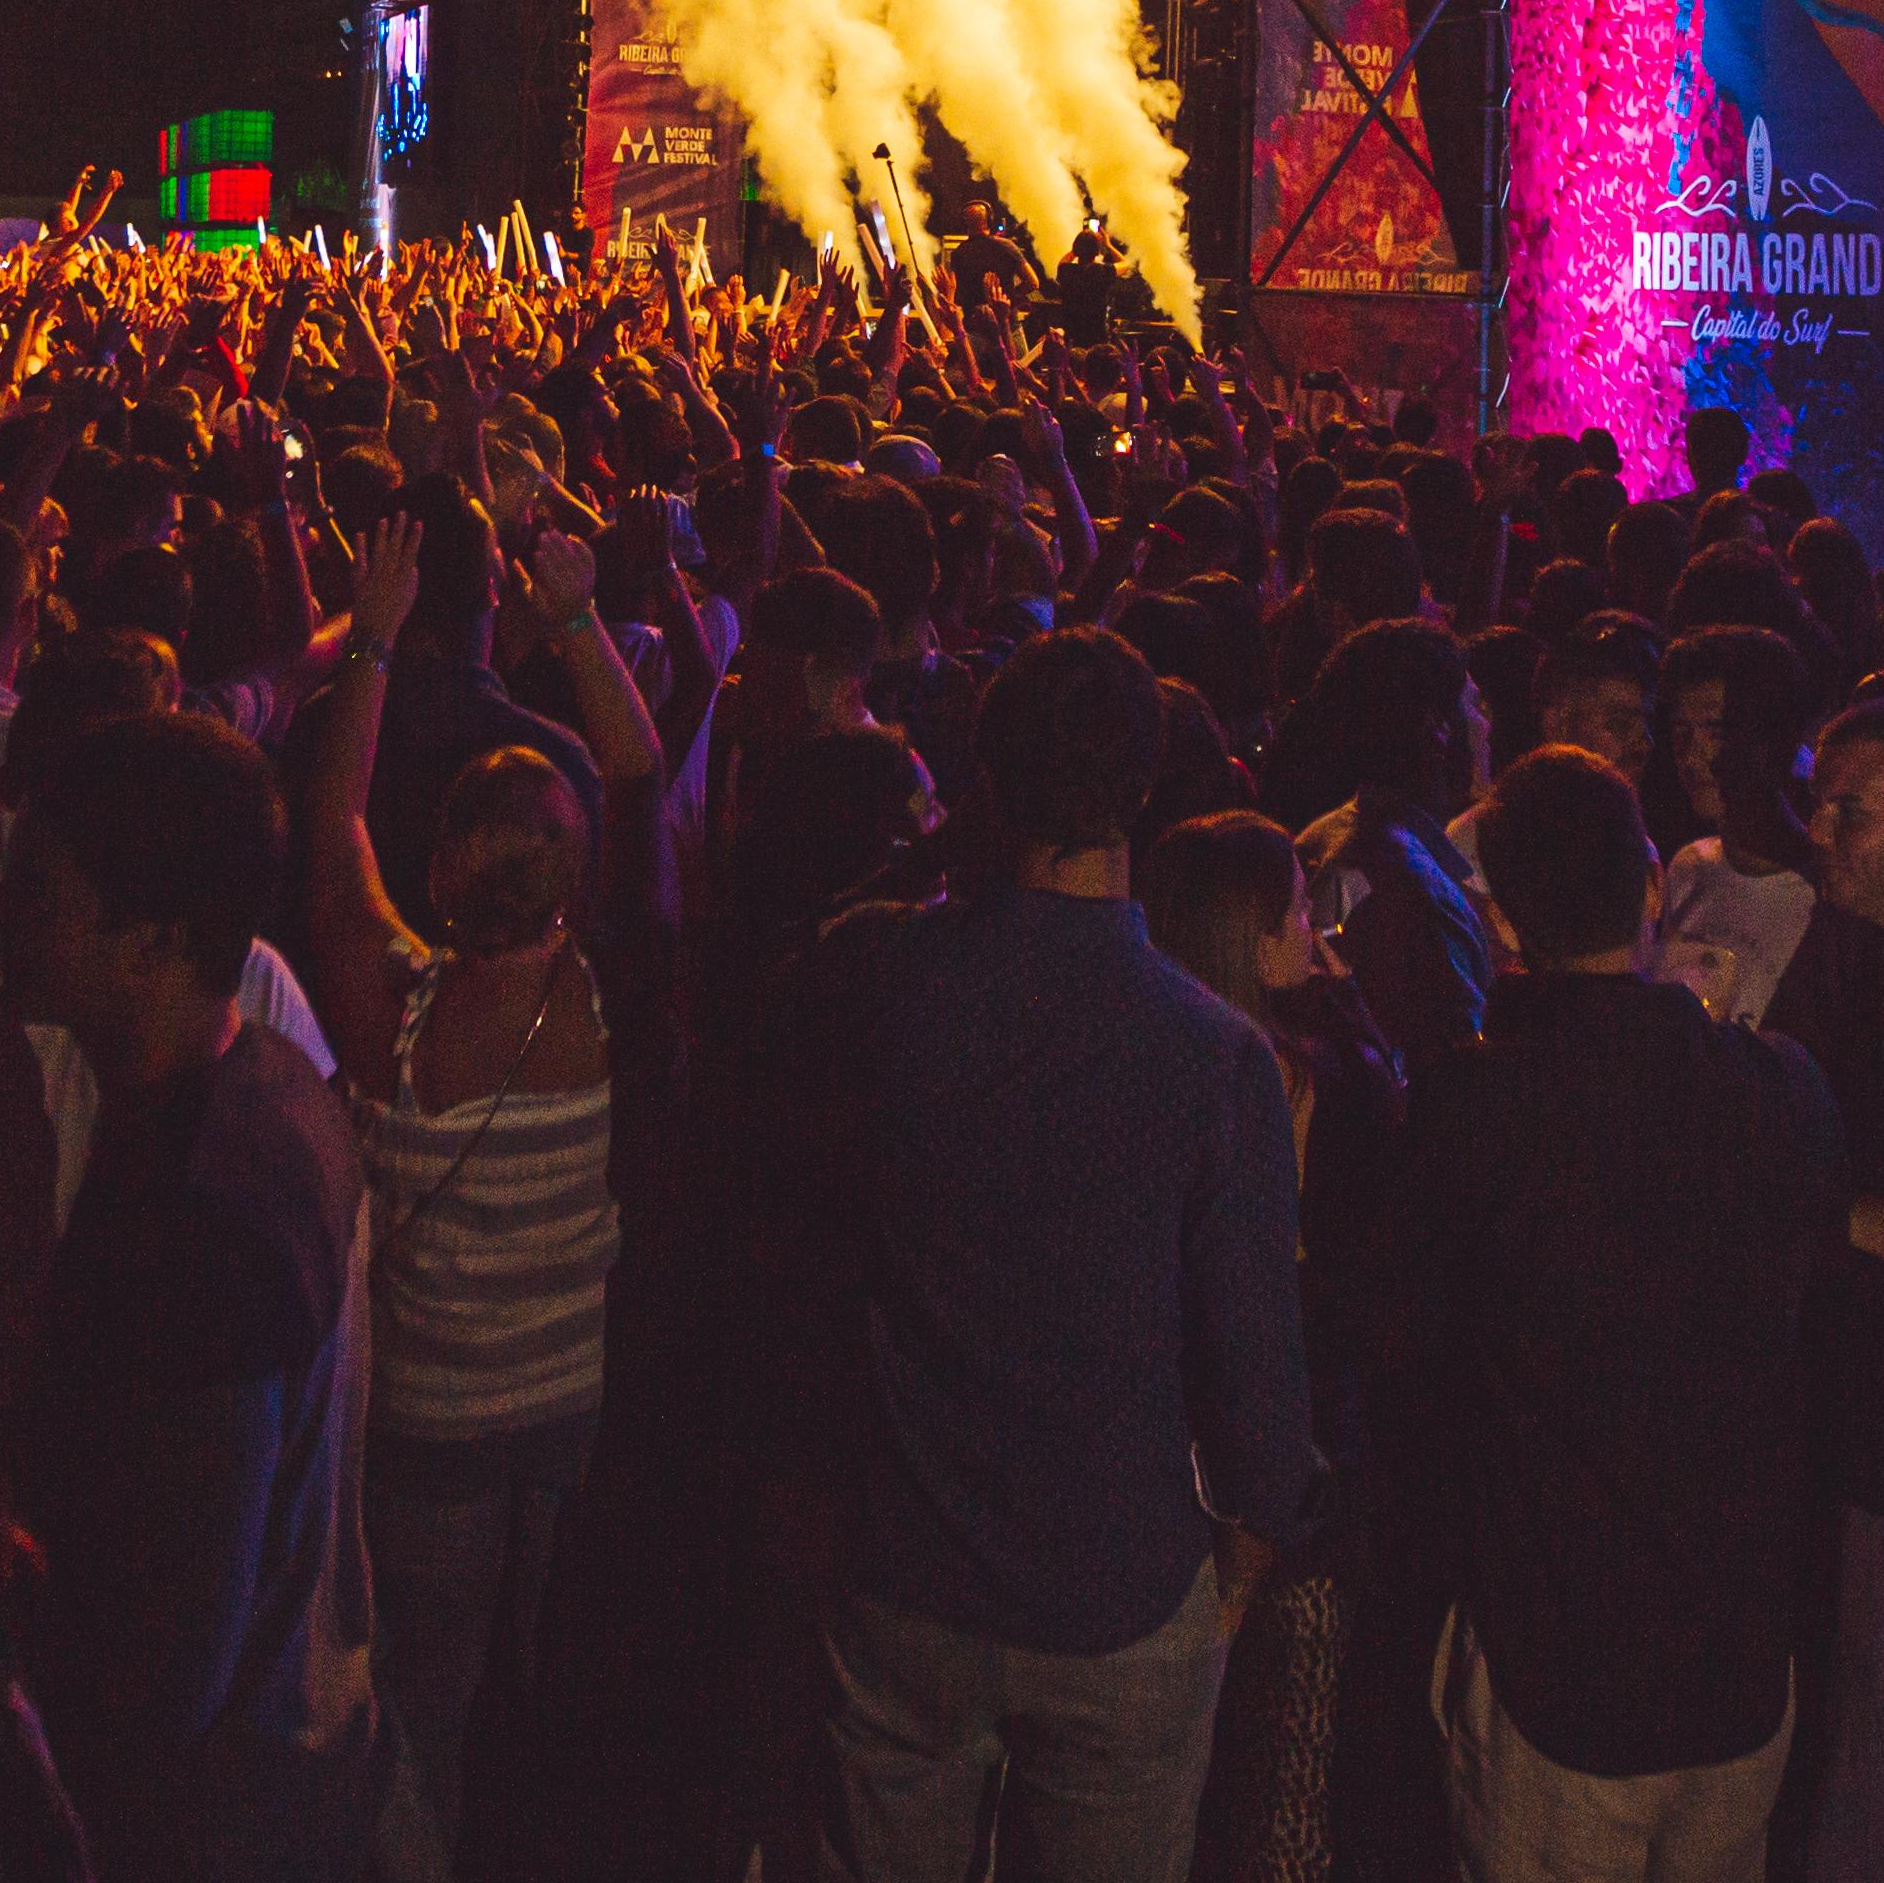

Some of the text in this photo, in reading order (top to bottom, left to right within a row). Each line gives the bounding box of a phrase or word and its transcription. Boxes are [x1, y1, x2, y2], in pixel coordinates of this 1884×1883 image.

[619, 44, 668, 63] RIBEIRA
[665, 127, 713, 140] MONTE
[665, 139, 705, 152] VERDE
[664, 152, 718, 165] FESTIVAL
[1753, 147, 1764, 195] AZORES
[1633, 231, 1753, 293] RIBEIRA
[1691, 304, 1834, 354] Capital do Surf
